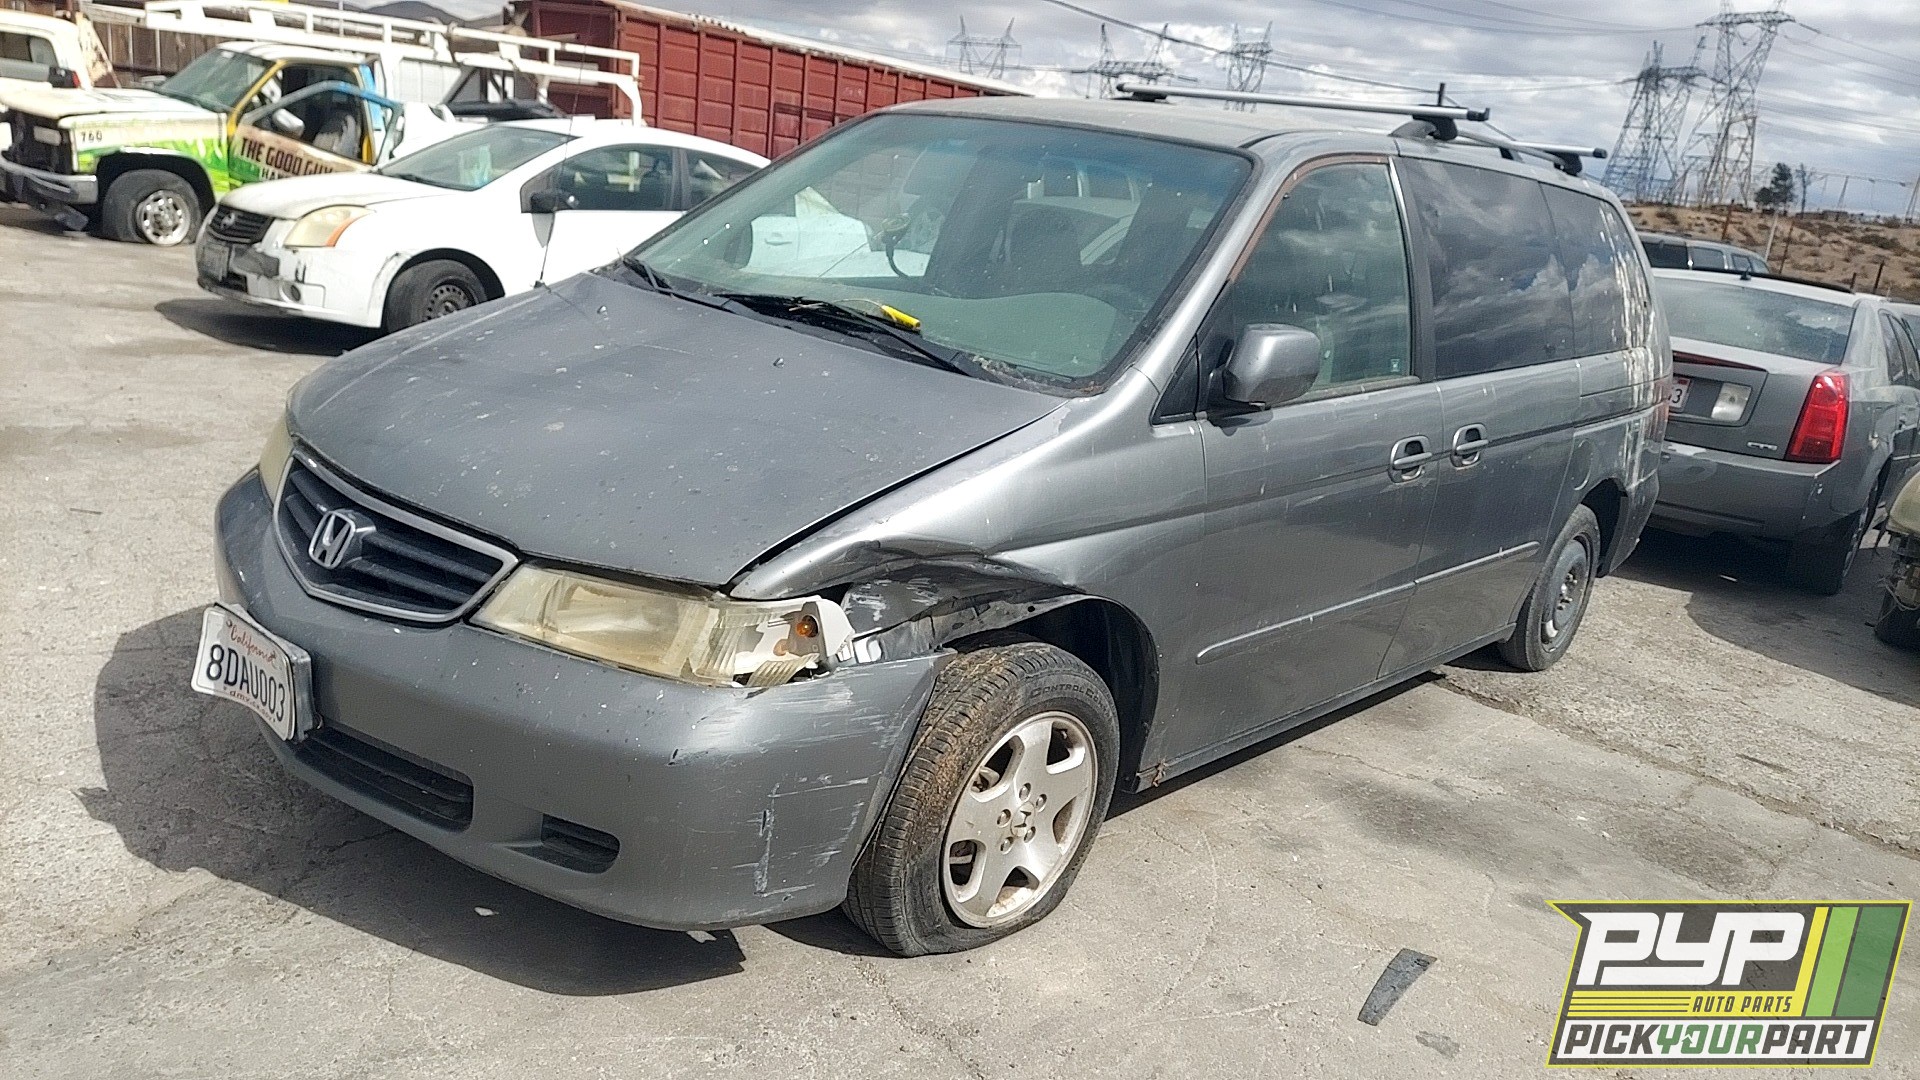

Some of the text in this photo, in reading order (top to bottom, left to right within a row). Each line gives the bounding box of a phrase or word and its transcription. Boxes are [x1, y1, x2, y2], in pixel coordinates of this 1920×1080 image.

[241, 138, 265, 162] THE
[266, 147, 302, 176] GOOD
[206, 644, 285, 722] 8DAU003
